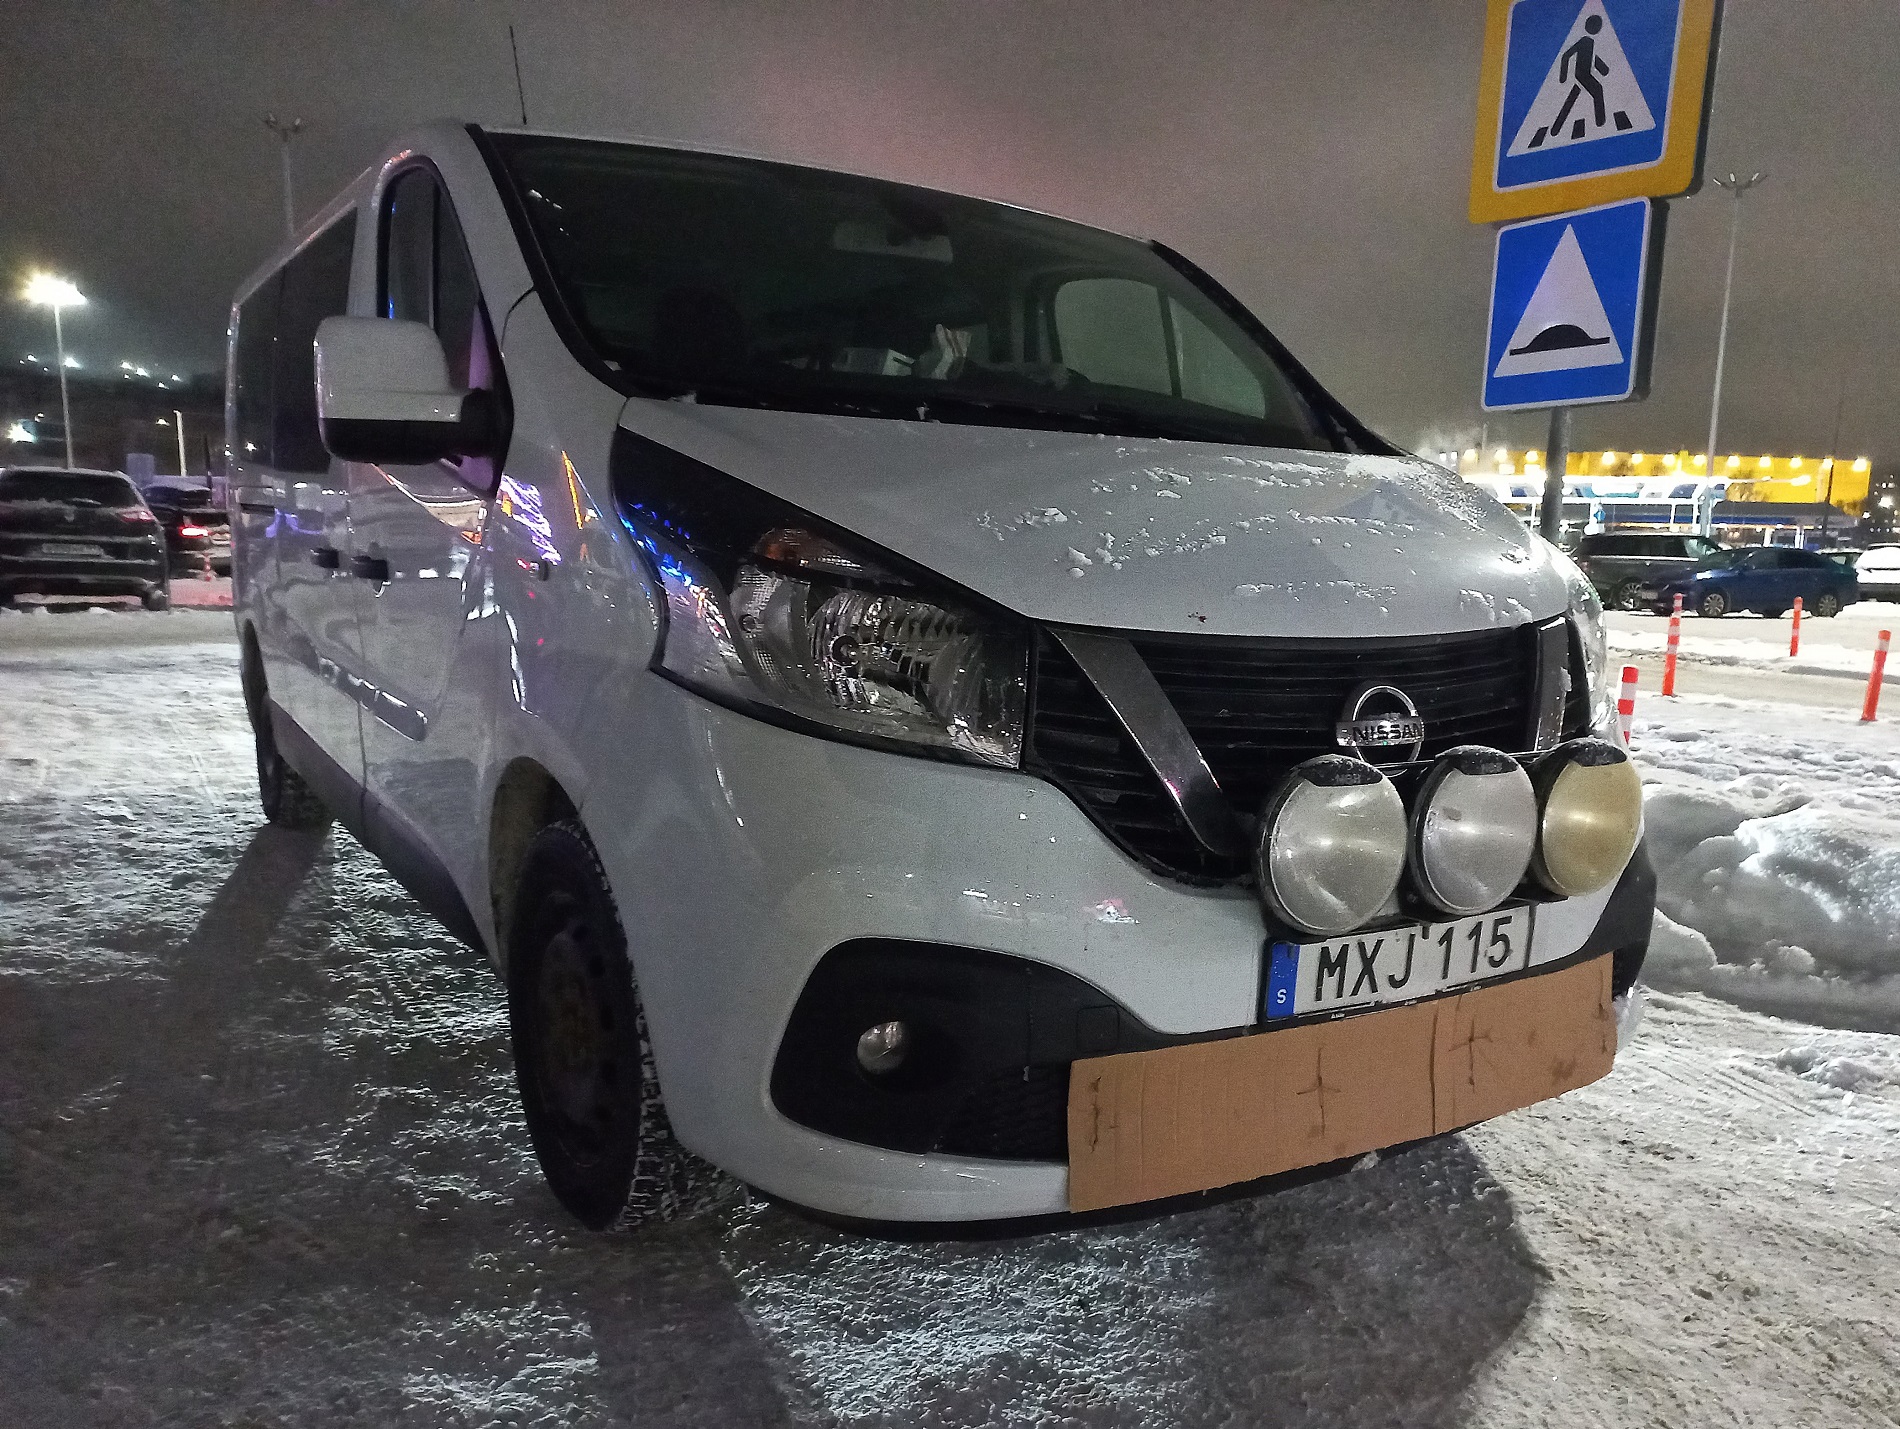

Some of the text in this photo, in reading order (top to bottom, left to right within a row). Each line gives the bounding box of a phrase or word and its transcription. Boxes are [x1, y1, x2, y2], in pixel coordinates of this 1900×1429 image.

[1353, 723, 1423, 741] NISSAN
[1315, 916, 1513, 1001] MXJ 115
[1276, 988, 1287, 1004] S
